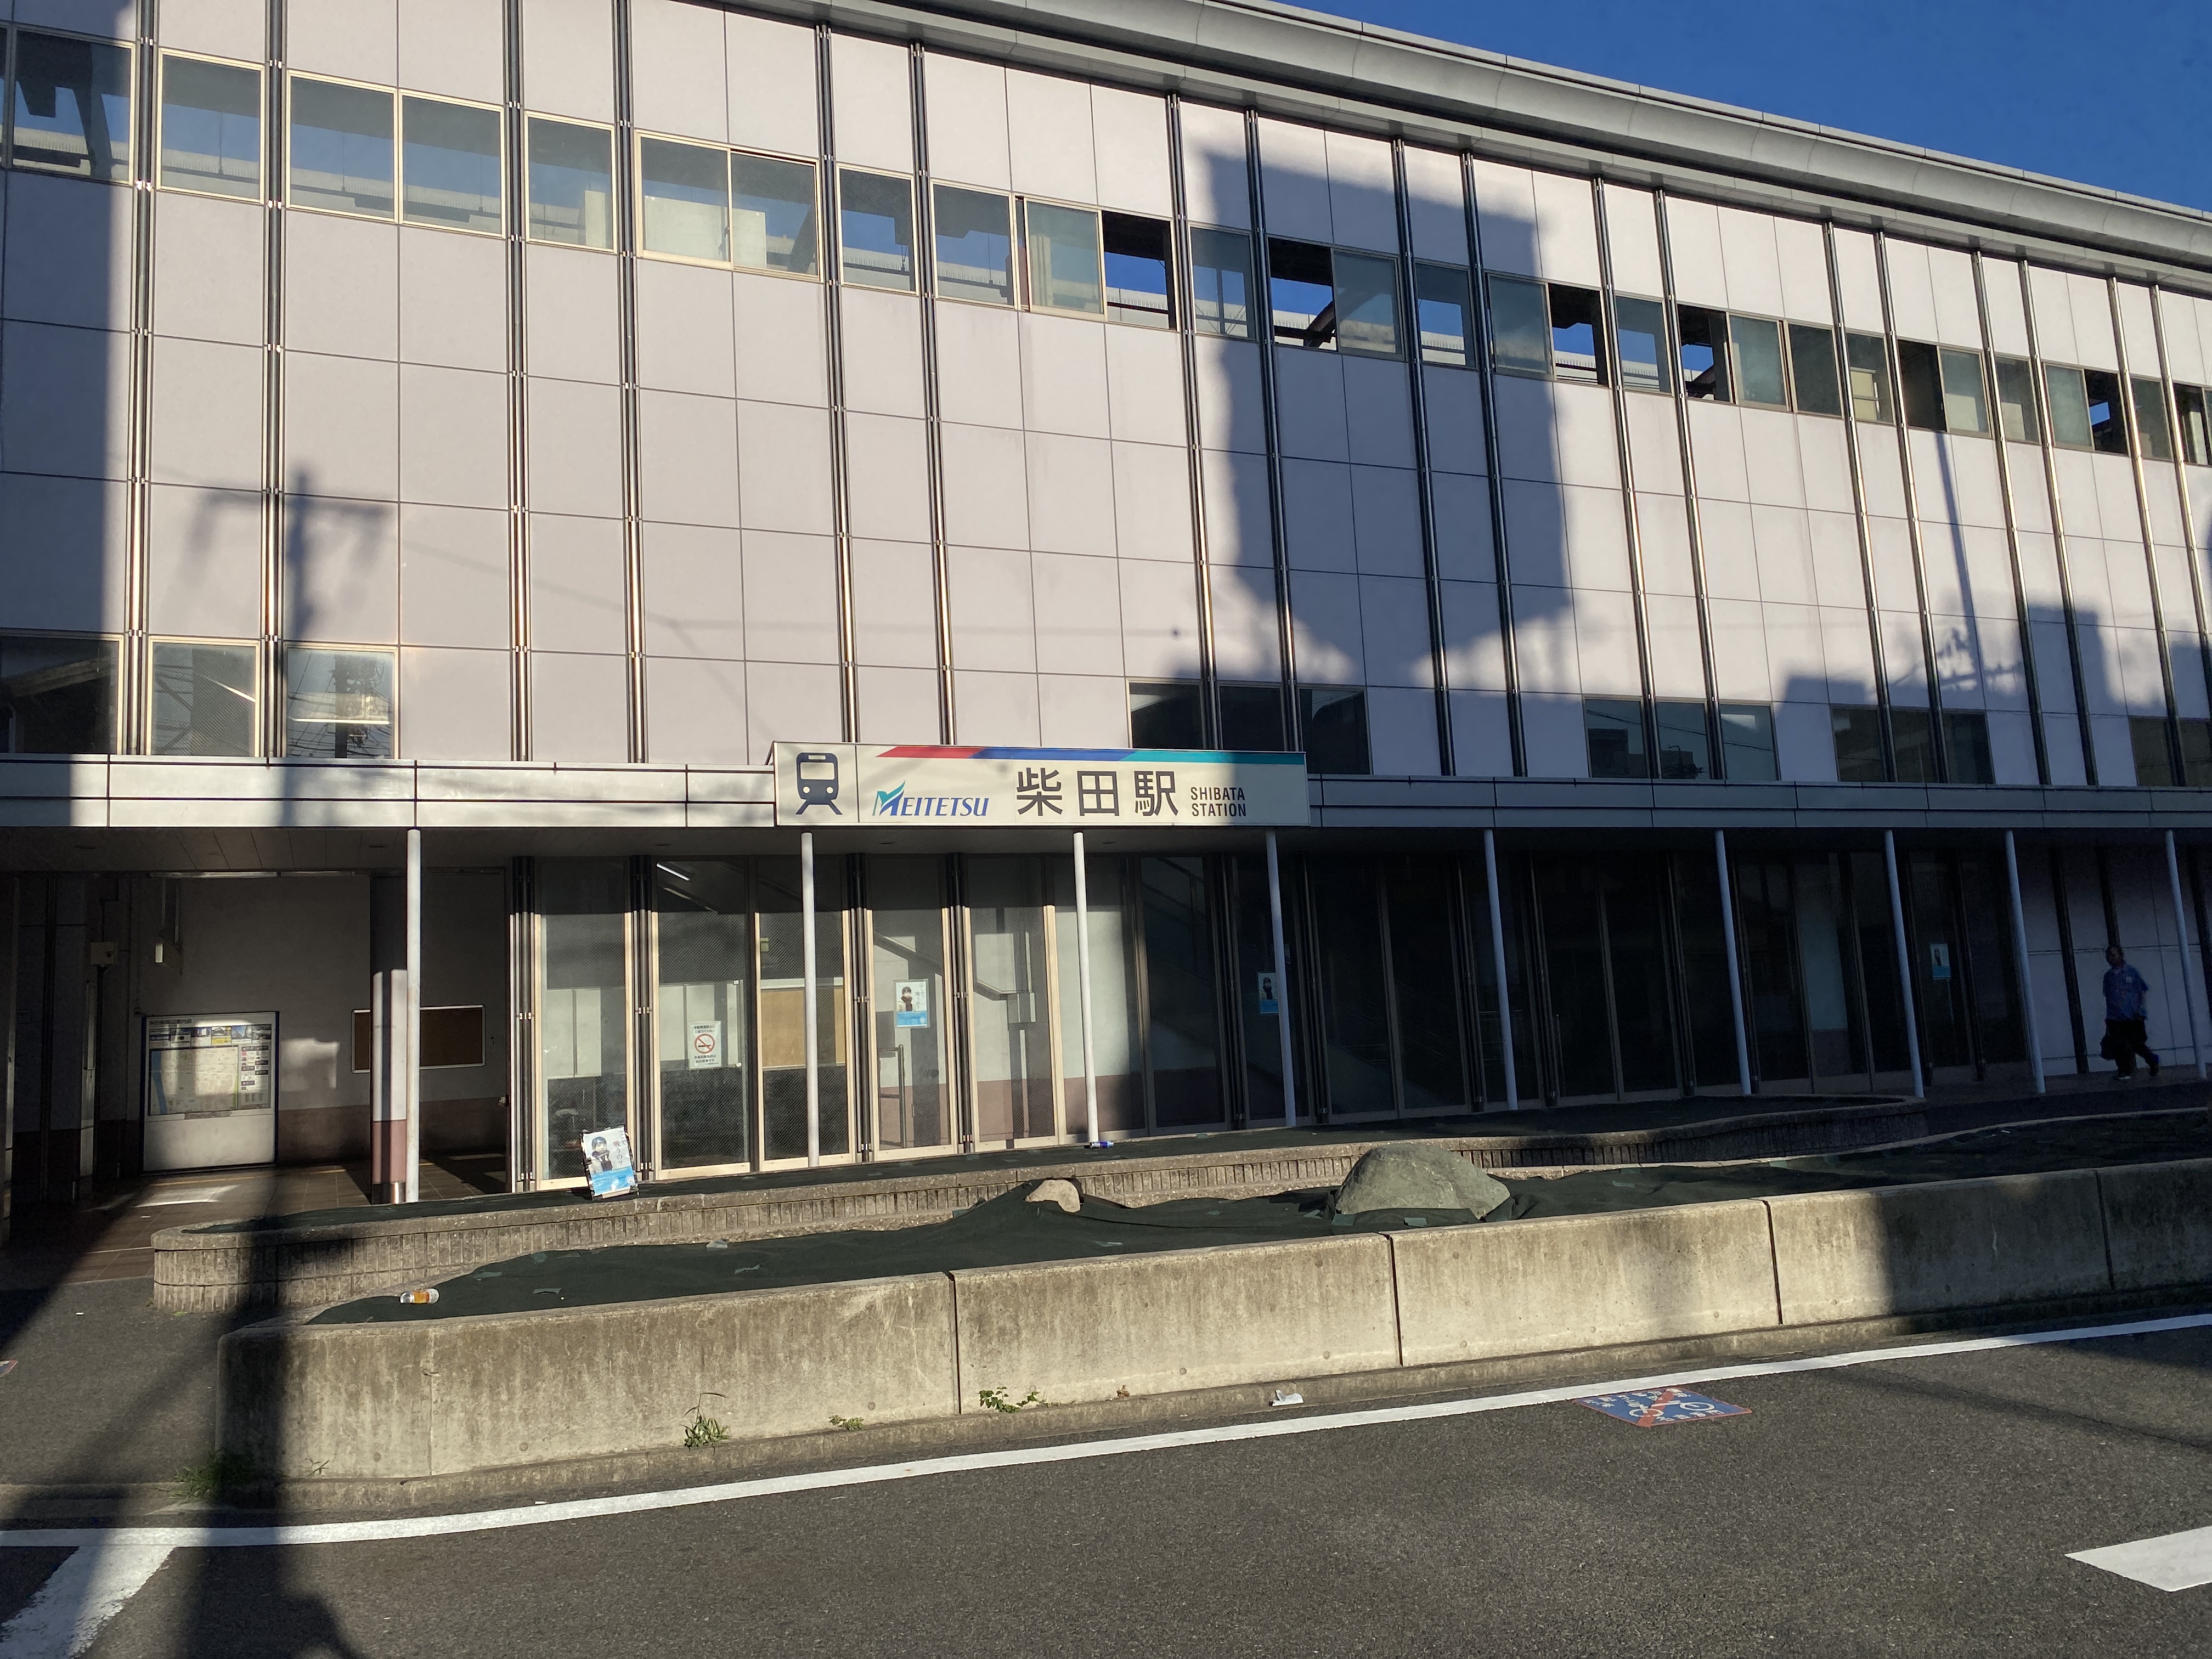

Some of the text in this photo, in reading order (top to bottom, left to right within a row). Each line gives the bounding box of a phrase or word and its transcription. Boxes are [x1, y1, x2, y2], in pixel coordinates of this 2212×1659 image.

[872, 780, 990, 816] MEITETSU
[1016, 767, 1179, 816] 柴田駅
[1190, 787, 1245, 800] SHIBATA
[1192, 803, 1246, 817] STATION
